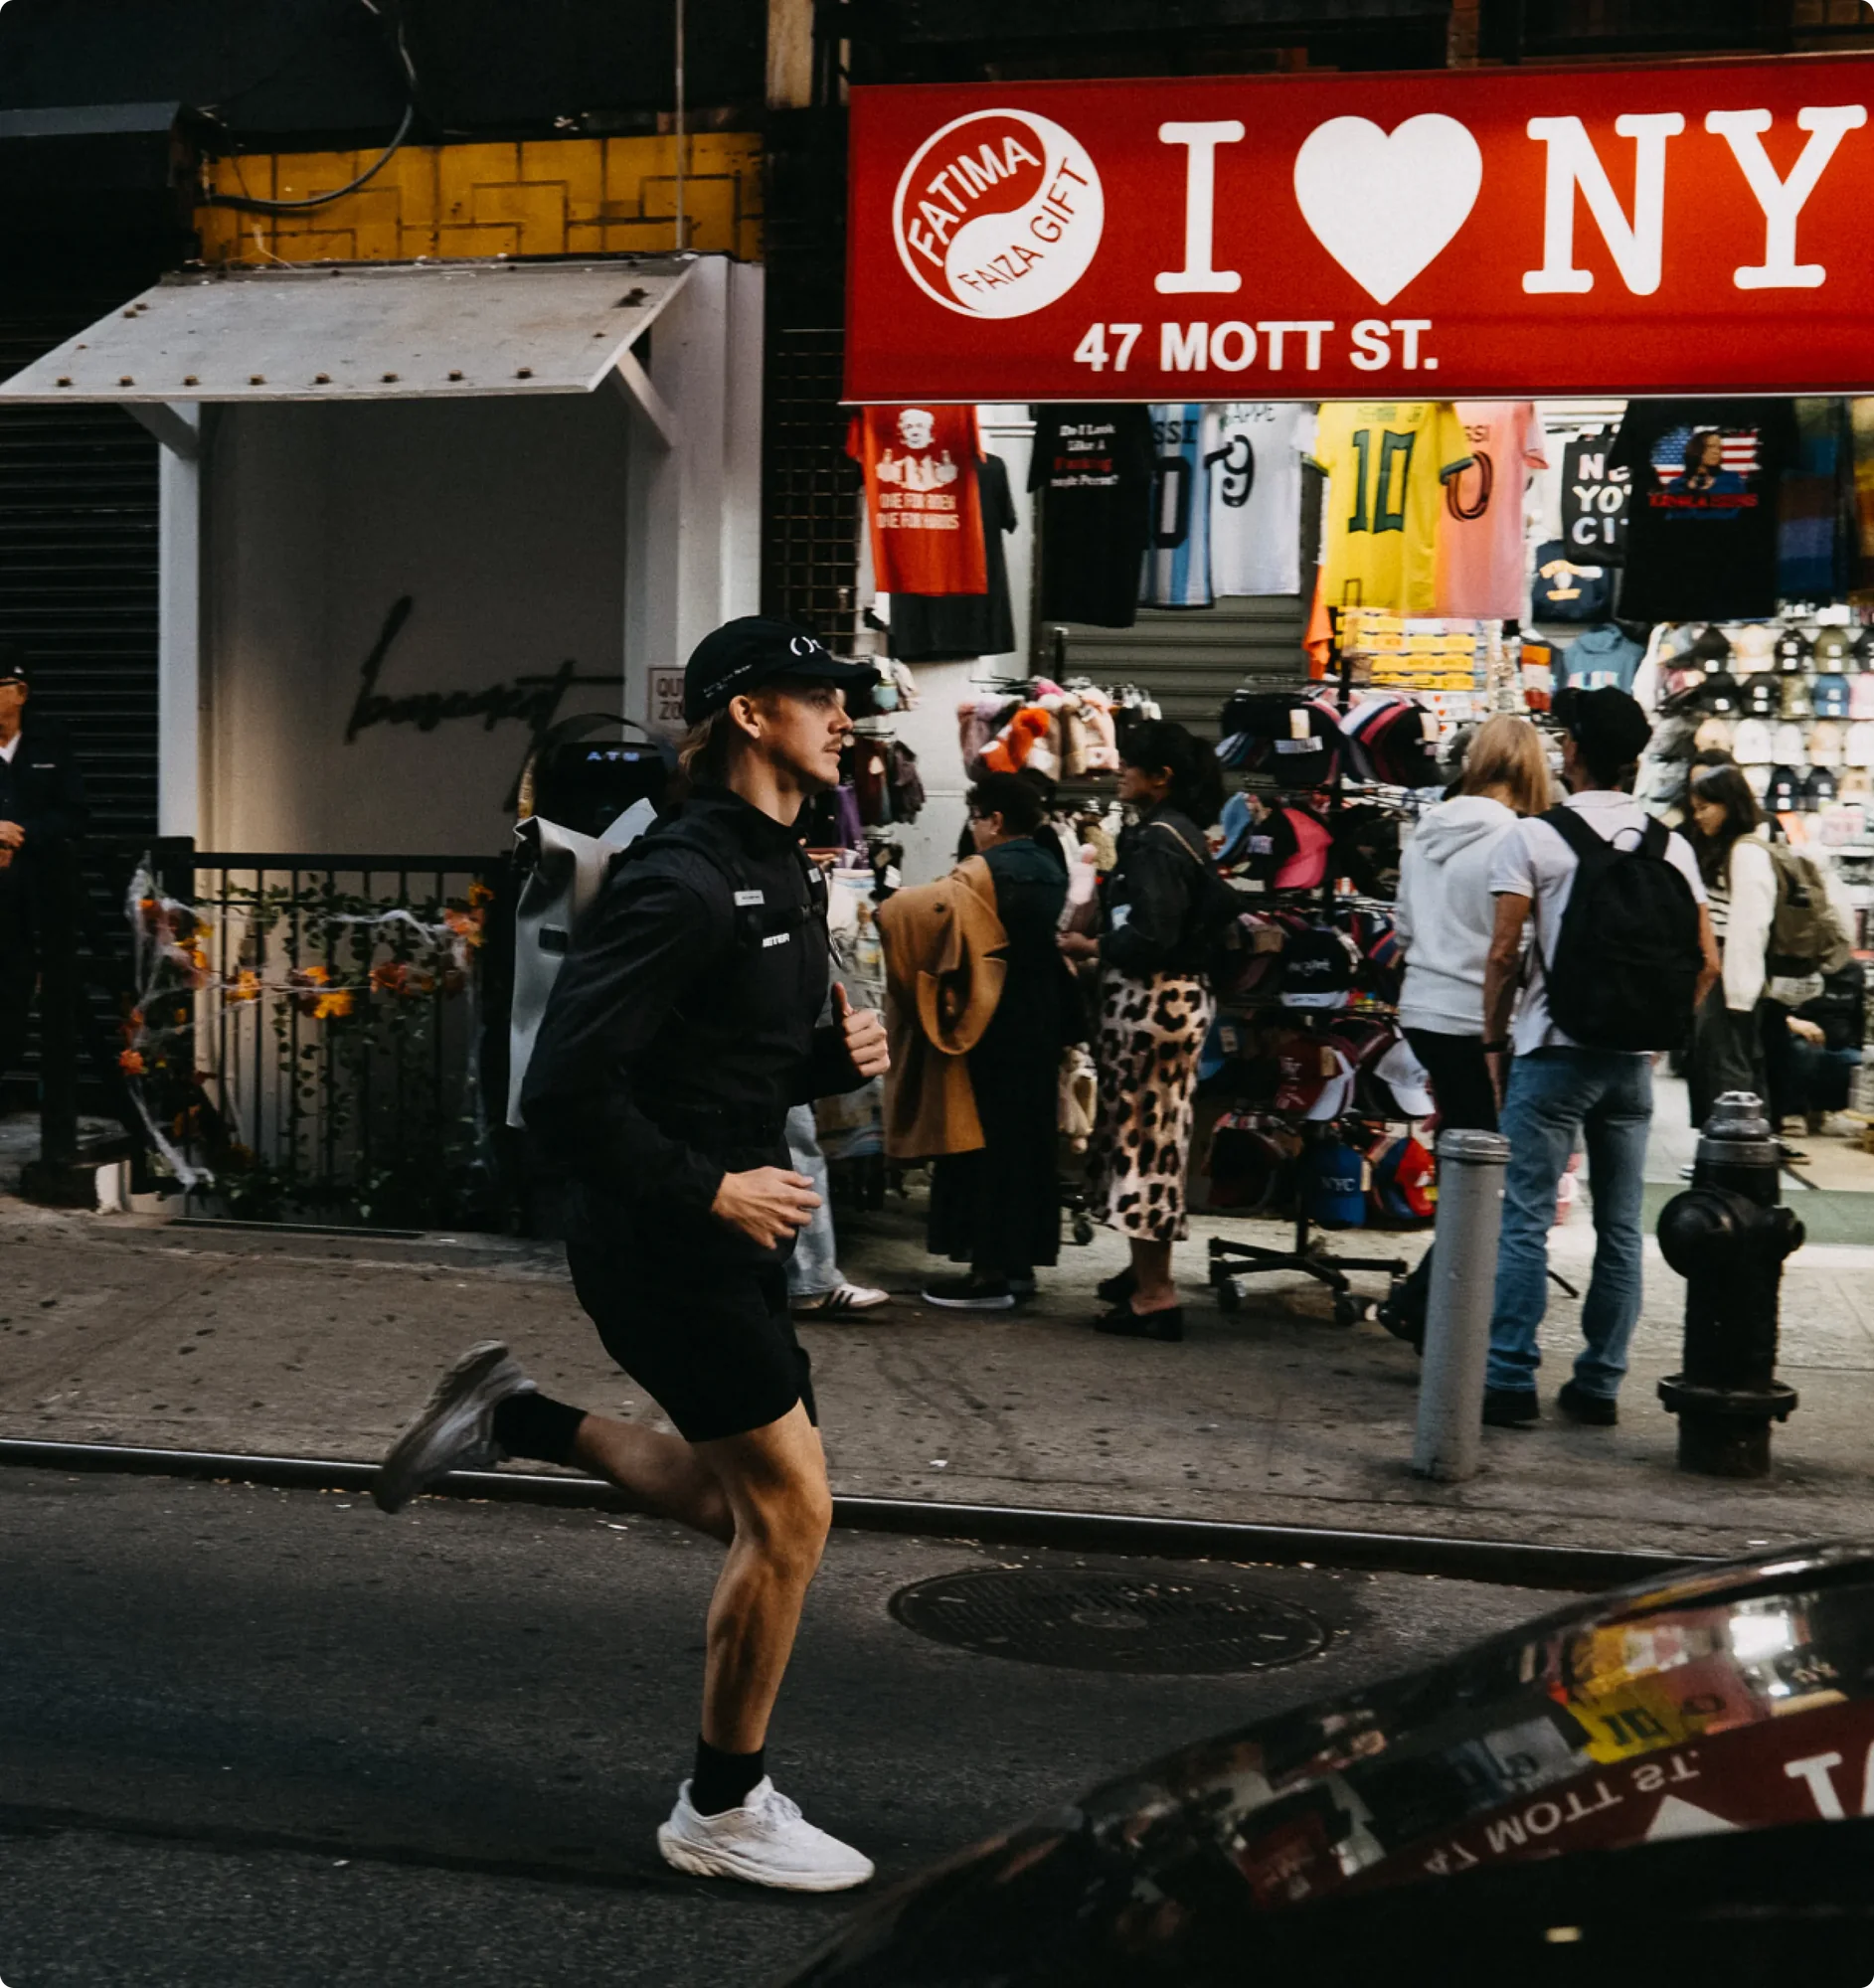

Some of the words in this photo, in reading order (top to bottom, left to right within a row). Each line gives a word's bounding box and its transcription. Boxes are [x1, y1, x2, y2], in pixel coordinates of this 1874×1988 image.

[907, 135, 1042, 267] FATIMA
[956, 245, 1045, 293] FAIZA
[1029, 156, 1090, 244] GIFT
[1155, 120, 1245, 294] I
[1522, 104, 1868, 297] NY
[1074, 322, 1142, 373] 47
[1161, 319, 1334, 372] MOTT
[1350, 318, 1439, 371] ST.
[1222, 433, 1256, 508] 9
[1347, 428, 1417, 535] 10
